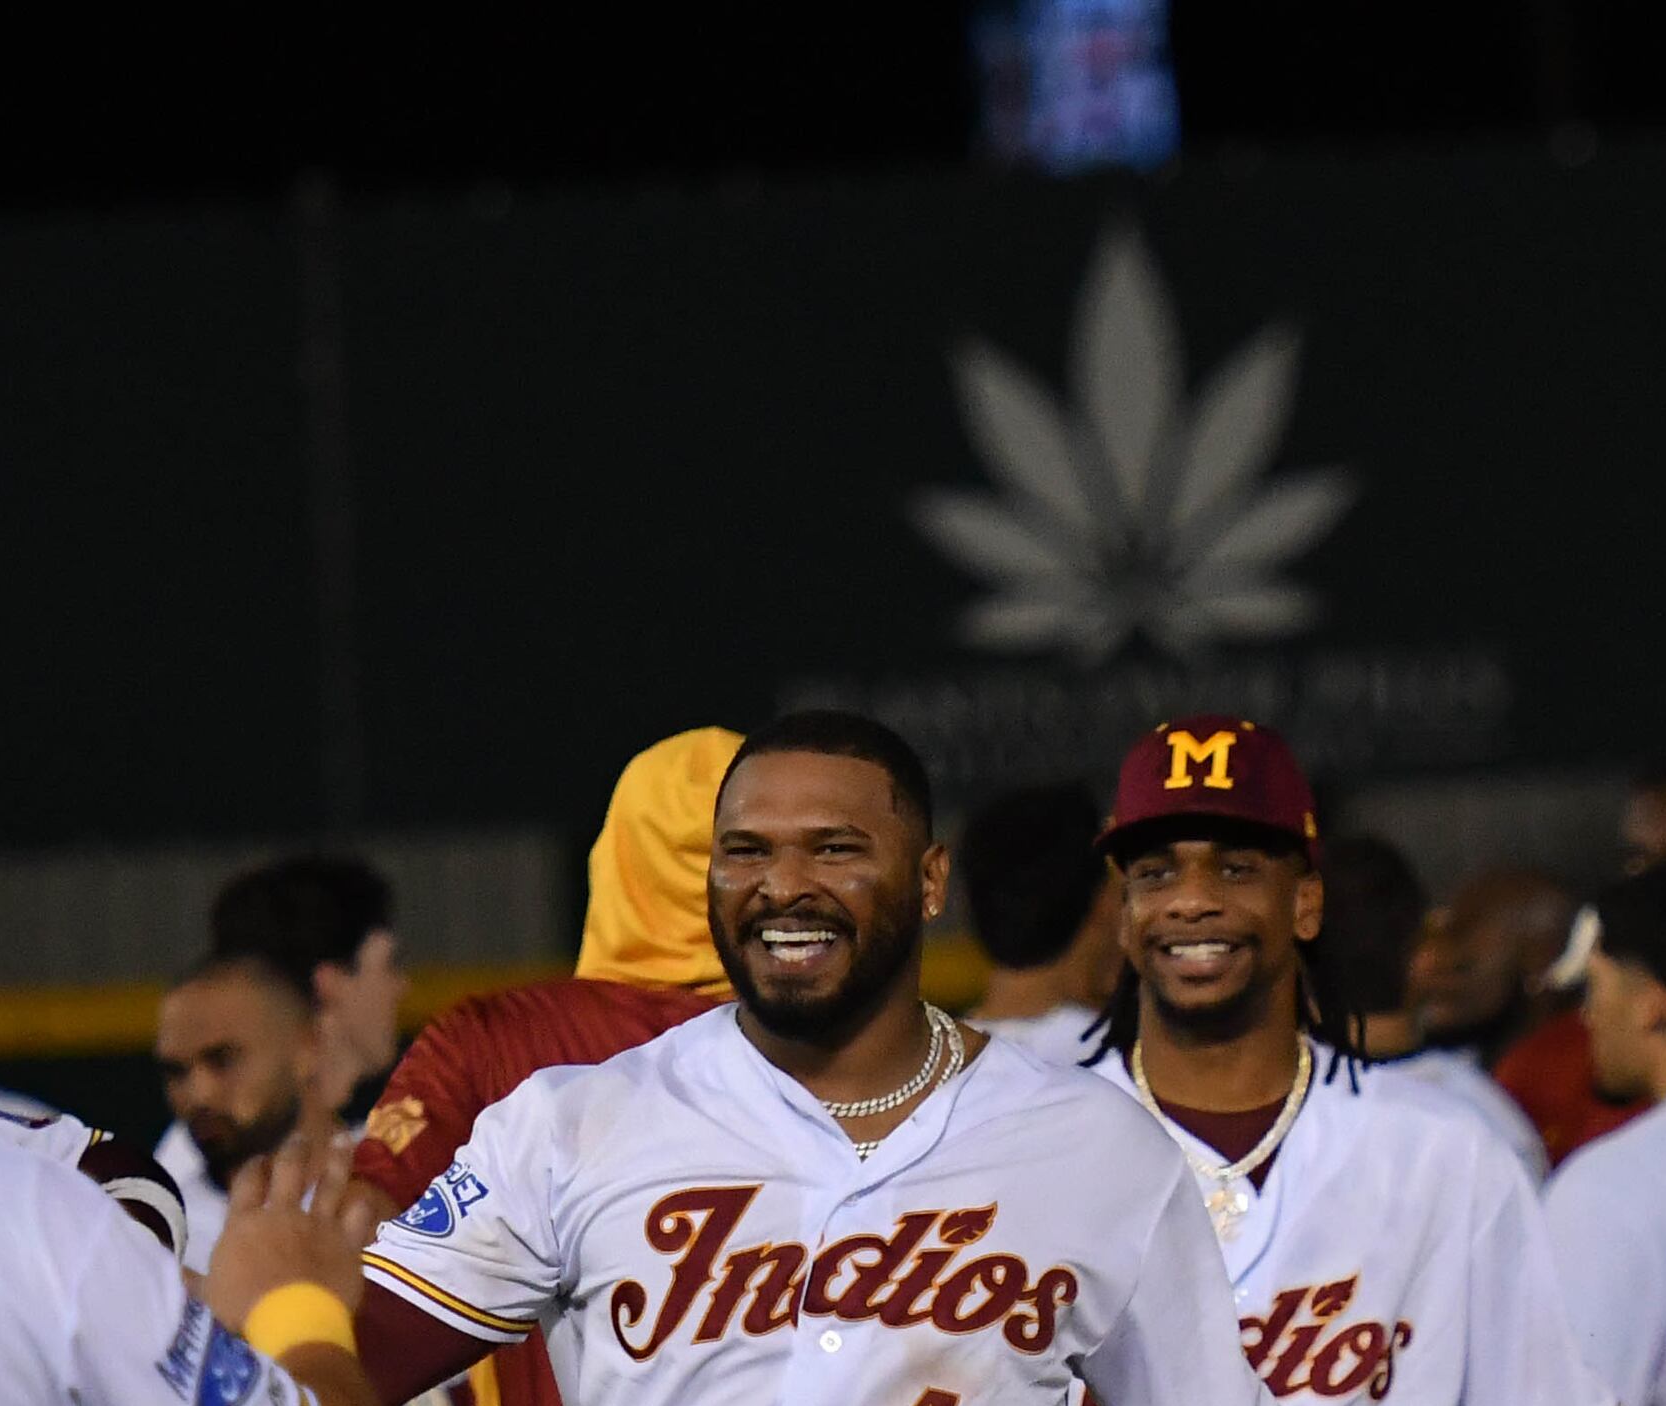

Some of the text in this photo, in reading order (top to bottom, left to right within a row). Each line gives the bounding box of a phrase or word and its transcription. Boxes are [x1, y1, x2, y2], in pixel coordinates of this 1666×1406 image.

[1164, 730, 1236, 789] M
[610, 1183, 1078, 1363] Indios
[1238, 1270, 1413, 1400] dios
